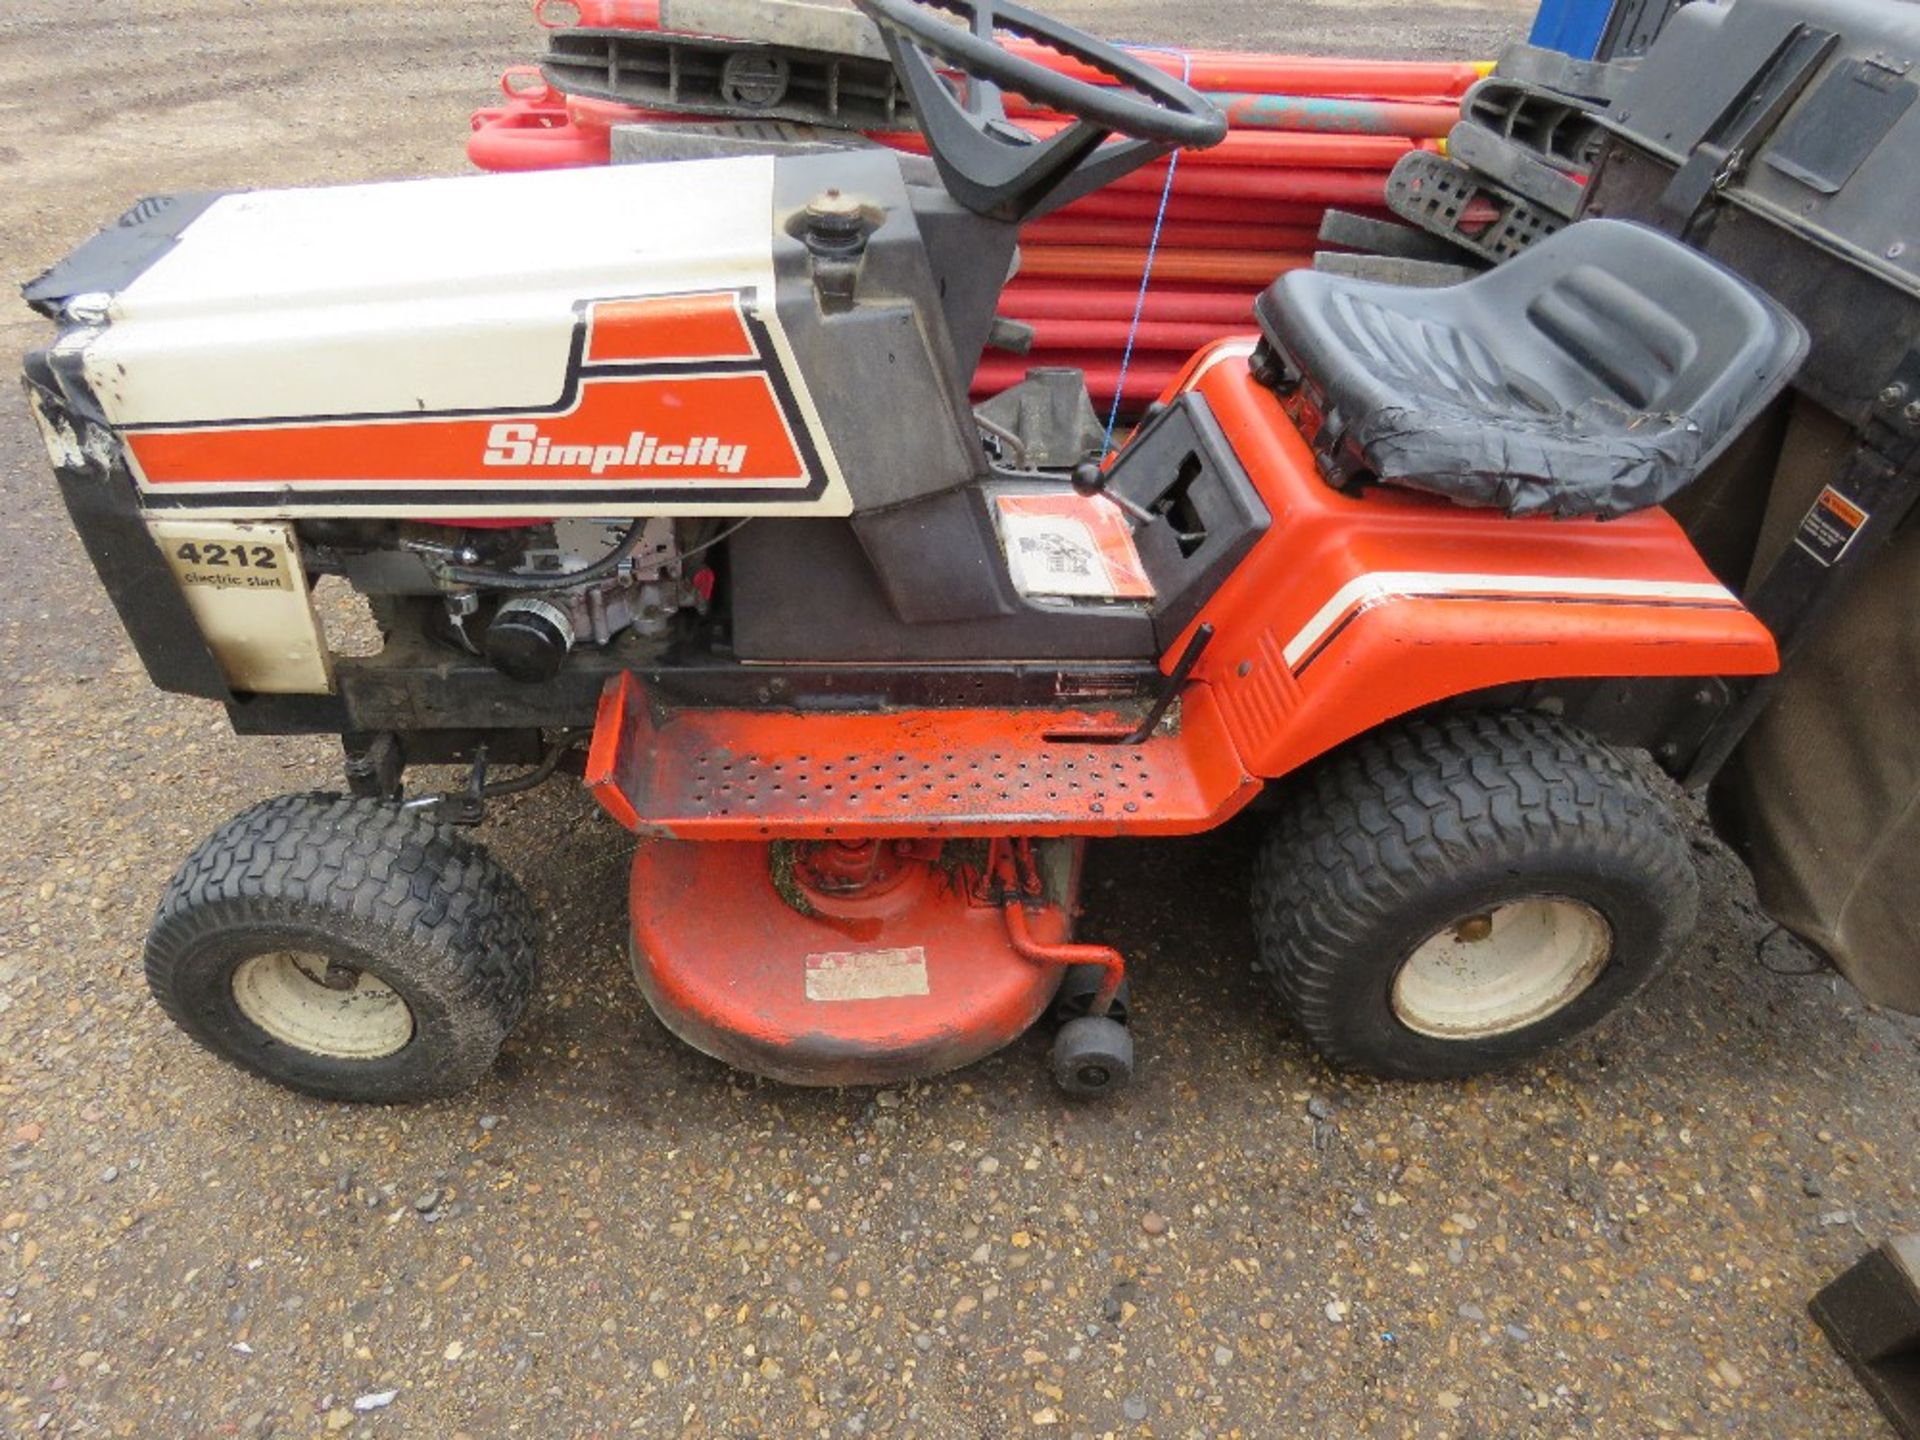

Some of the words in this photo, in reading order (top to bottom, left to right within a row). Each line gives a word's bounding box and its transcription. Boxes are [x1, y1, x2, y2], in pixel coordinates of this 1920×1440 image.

[483, 423, 748, 474] Simplicity
[177, 543, 277, 569] 4212
[247, 577, 281, 587] start
